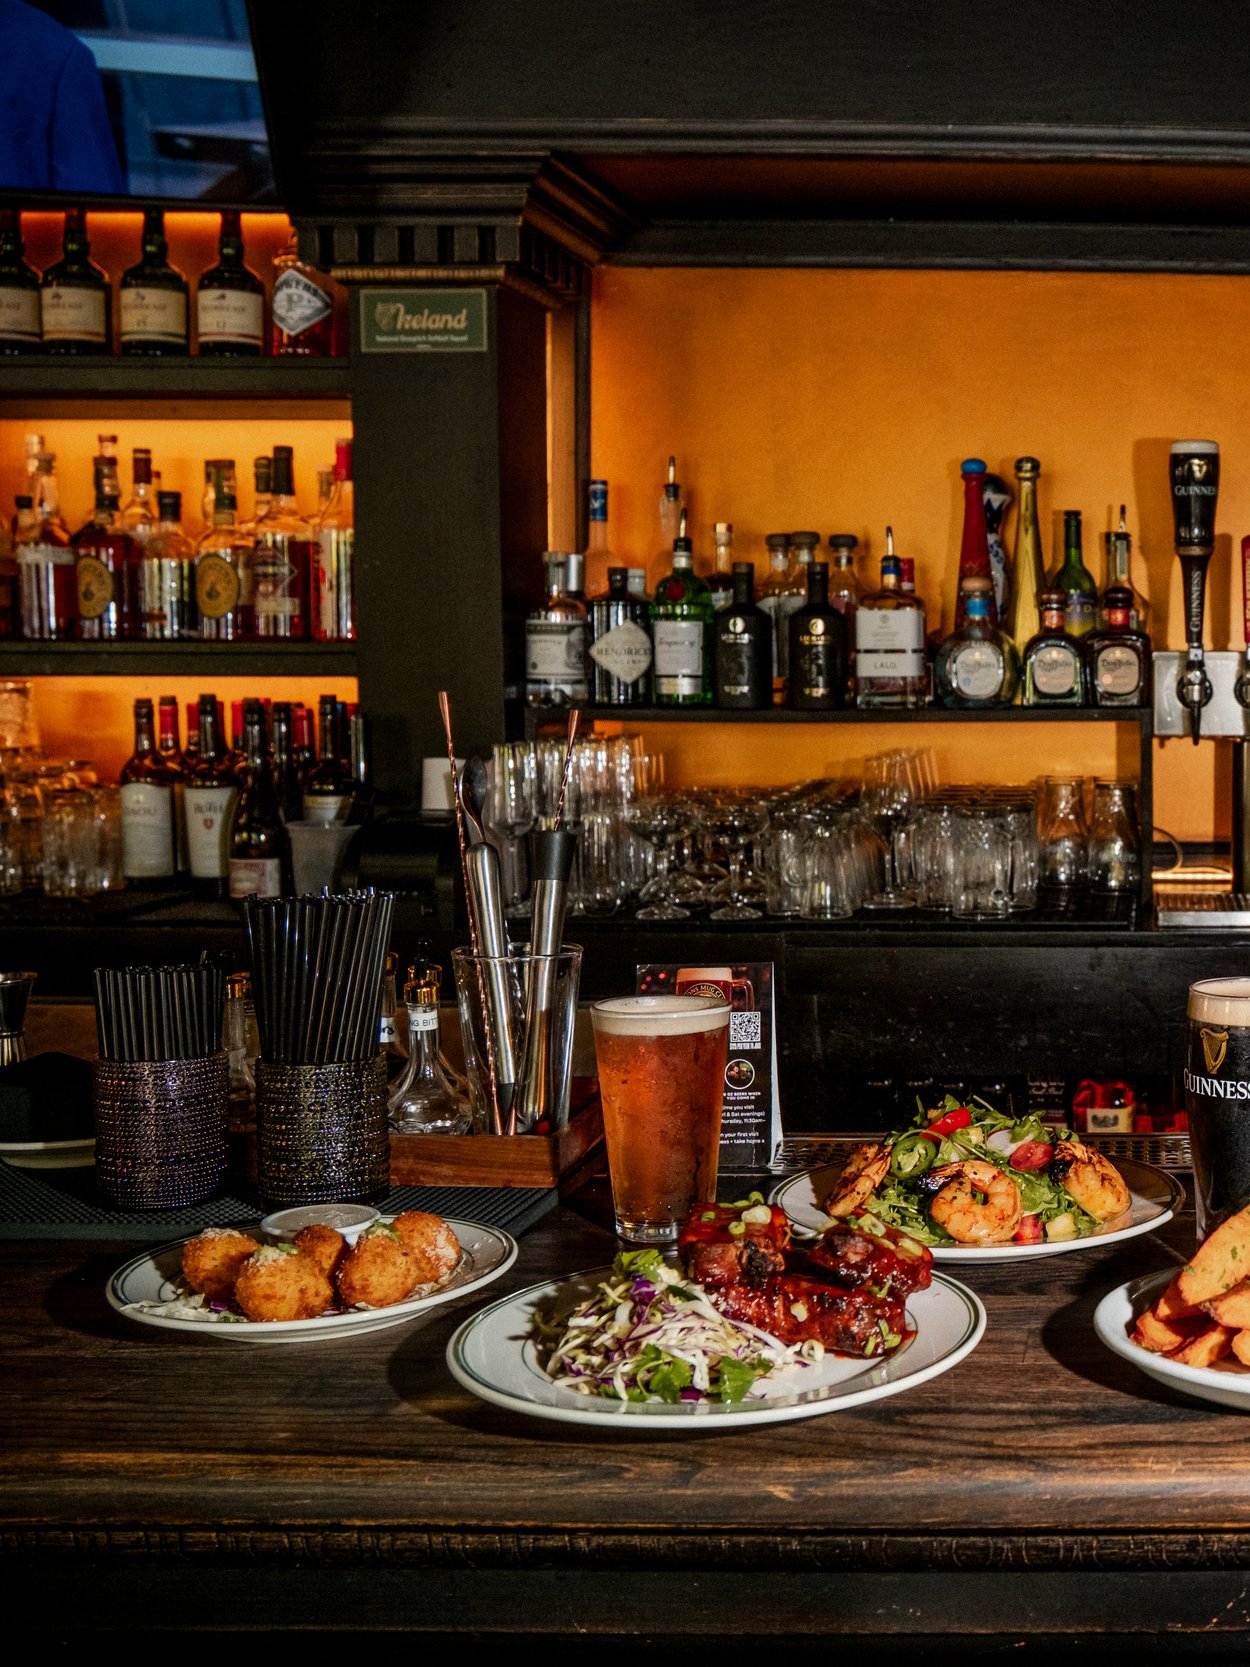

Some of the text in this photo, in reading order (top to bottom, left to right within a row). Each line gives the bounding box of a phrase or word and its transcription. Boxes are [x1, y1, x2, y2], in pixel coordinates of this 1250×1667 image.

[395, 303, 468, 330] Ireland
[1189, 570, 1202, 632] GUINNESS
[700, 985, 715, 994] MUG
